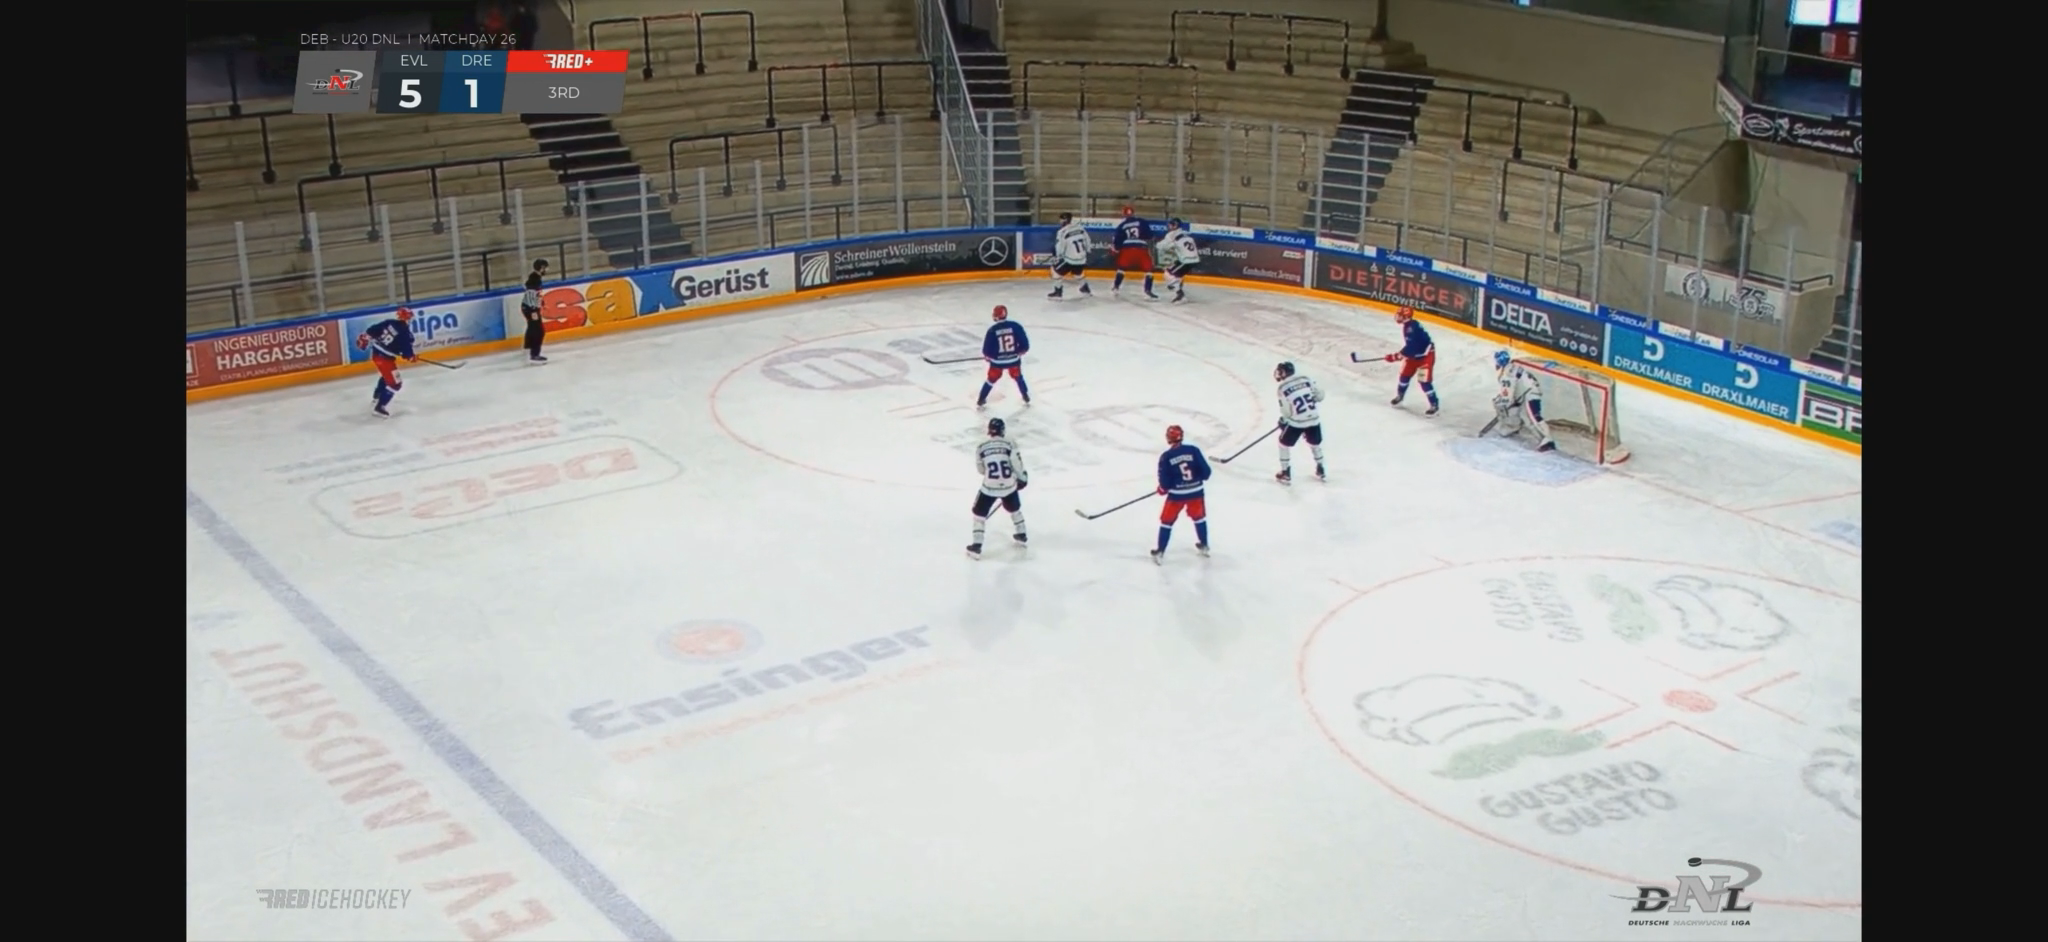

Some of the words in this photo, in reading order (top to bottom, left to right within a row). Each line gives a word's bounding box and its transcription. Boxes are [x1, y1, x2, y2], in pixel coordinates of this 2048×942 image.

[1125, 227, 1139, 239] 13
[541, 269, 686, 332] sax
[674, 267, 770, 302] Gerüst
[1329, 263, 1468, 311] DIETZINGER
[1370, 290, 1427, 311] AUTOWELT
[1491, 298, 1554, 336] DELTA
[213, 324, 327, 354] INGENIEURBÜRO
[215, 339, 328, 371] HARGASSER
[997, 335, 1015, 353] 12
[1293, 393, 1317, 415] 25
[987, 460, 1012, 479] 26
[1179, 463, 1193, 481] 5
[568, 624, 930, 740] Ensinger
[210, 643, 477, 863] LANDSHUT
[1479, 760, 1662, 819] GUSTAVO
[1536, 787, 1679, 836] GUSTO
[421, 871, 557, 942] EV
